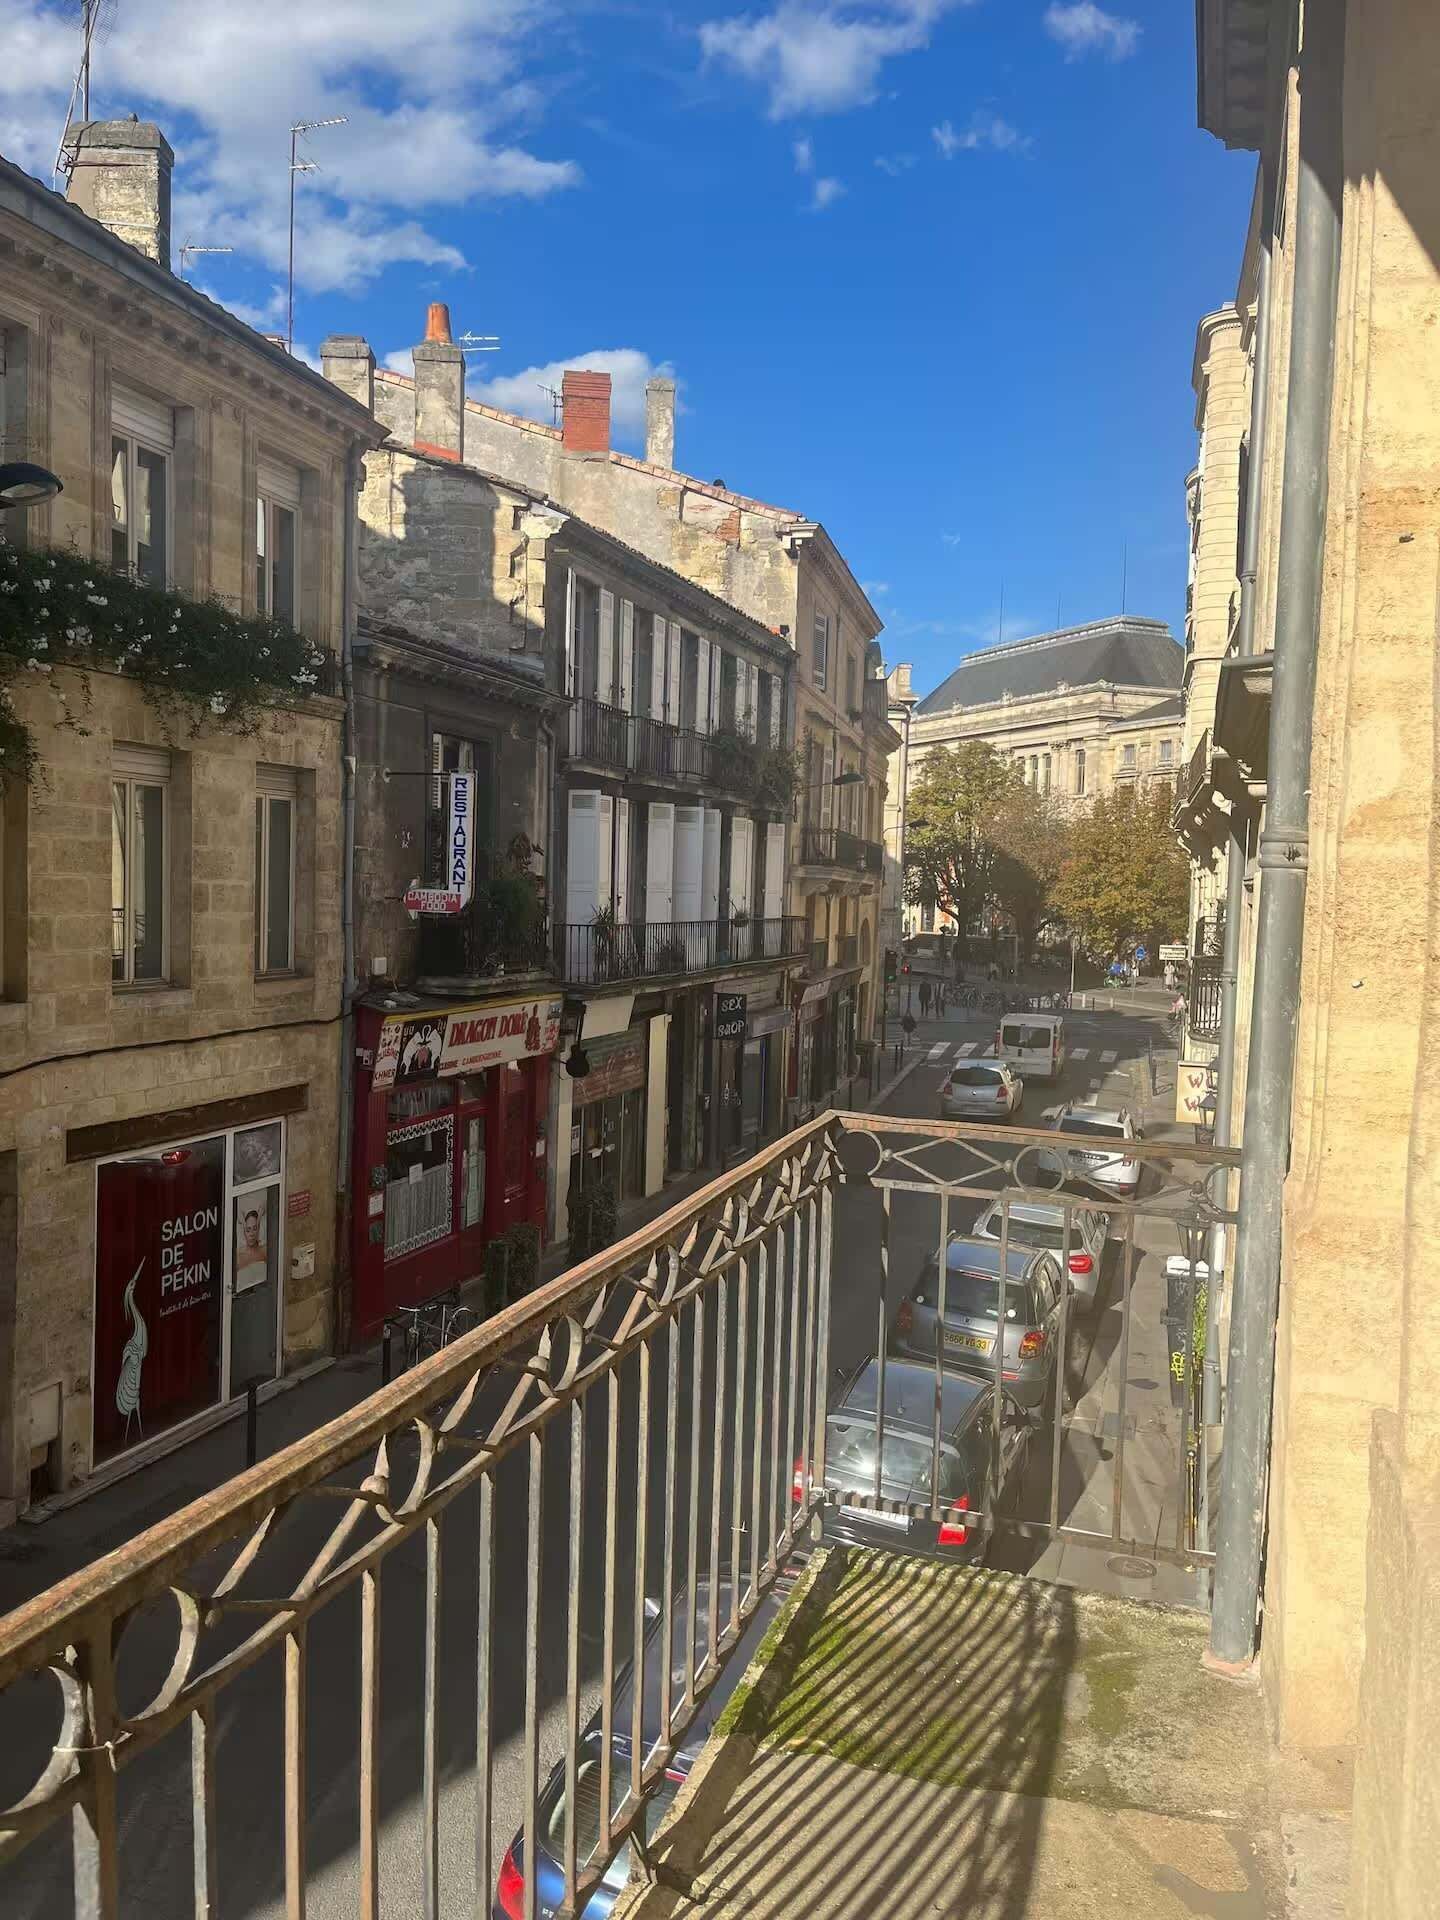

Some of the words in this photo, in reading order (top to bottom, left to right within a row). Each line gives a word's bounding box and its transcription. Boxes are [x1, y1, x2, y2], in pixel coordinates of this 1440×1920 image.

[453, 778, 467, 892] RESTAURANT
[407, 891, 457, 904] CAMBODIA
[420, 901, 447, 910] FOOD
[721, 996, 742, 1012] SEX
[448, 1016, 498, 1047] DRAGON
[161, 1206, 218, 1242] SALON
[161, 1242, 185, 1269] DE
[161, 1259, 211, 1297] PÉKIN
